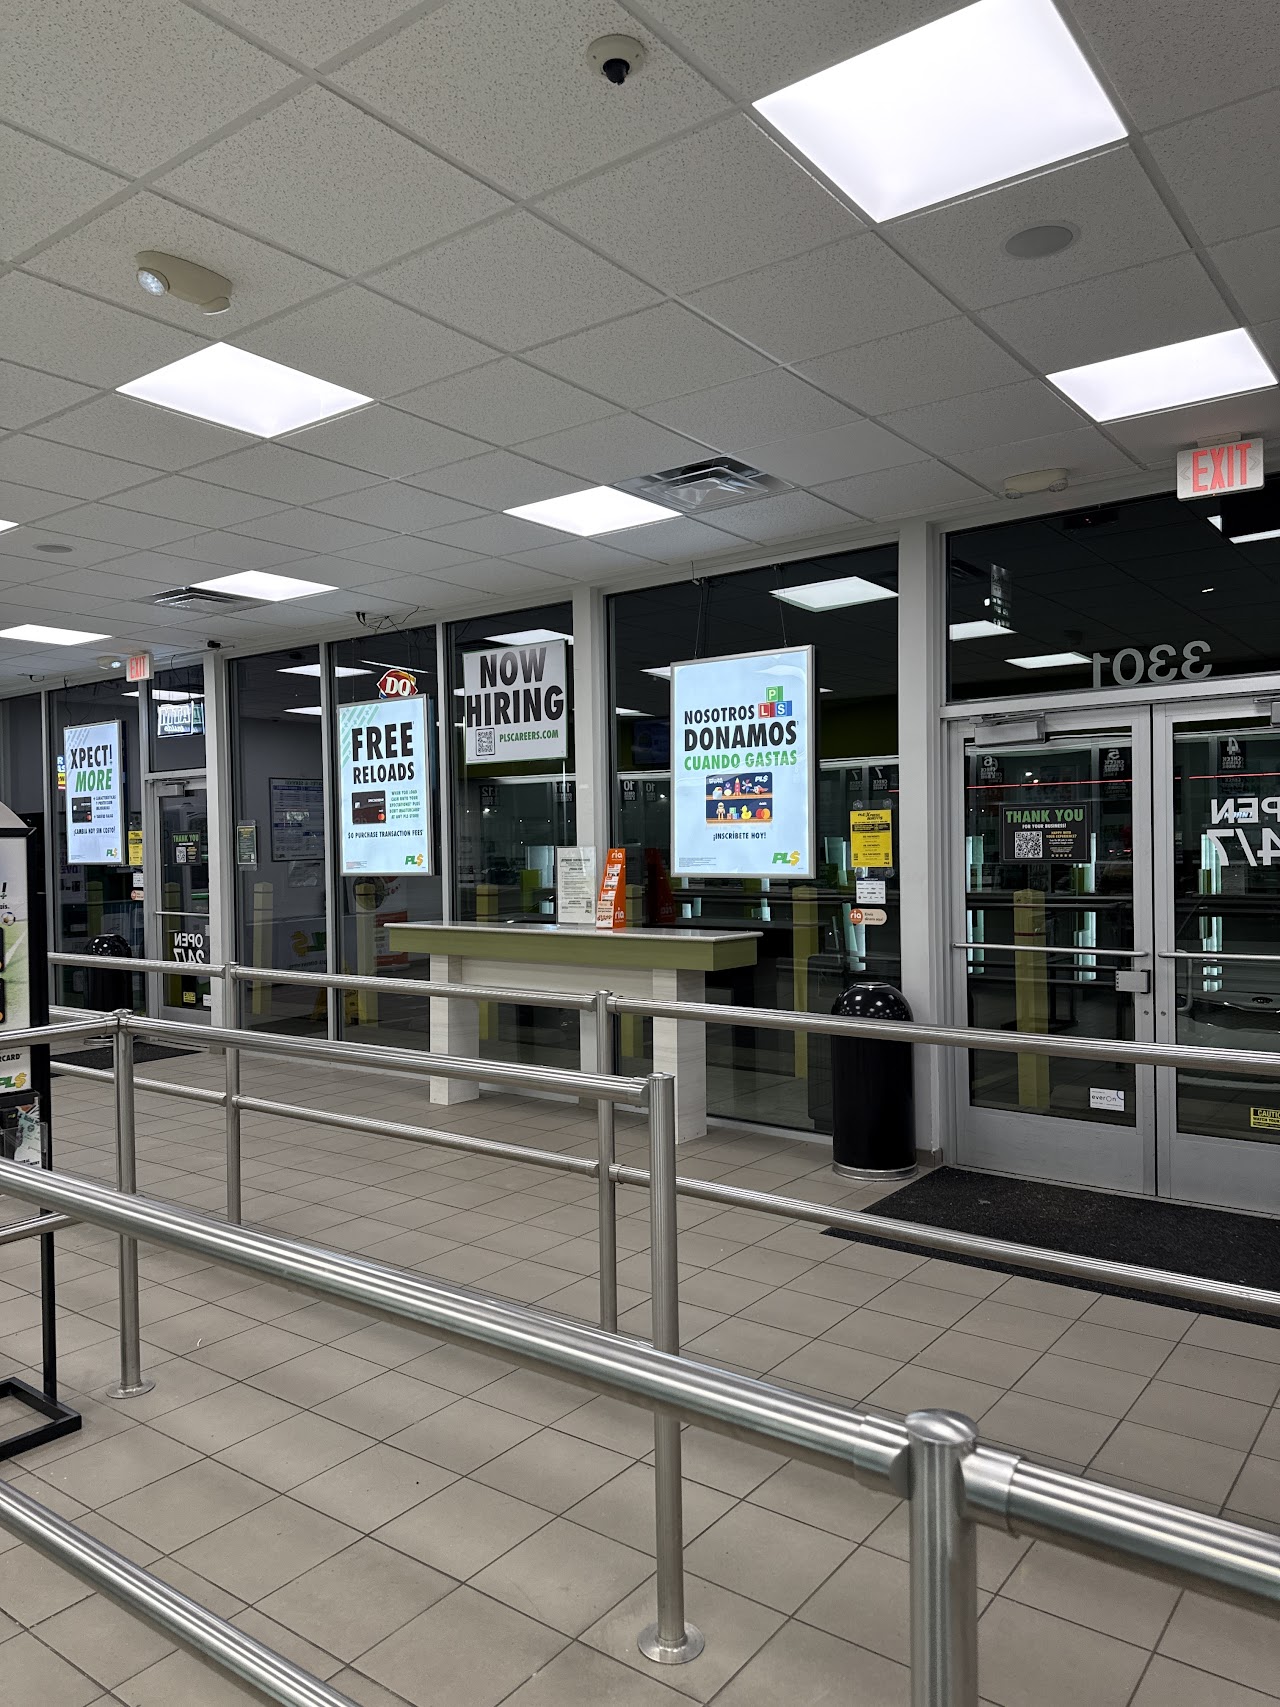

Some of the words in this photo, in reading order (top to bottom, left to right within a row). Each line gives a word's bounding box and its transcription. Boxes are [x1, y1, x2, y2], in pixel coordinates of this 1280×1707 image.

[1192, 443, 1252, 493] EXIT
[130, 656, 146, 679] EXIT
[480, 647, 547, 689] NOW
[385, 676, 411, 696] DQ
[768, 689, 776, 700] P
[466, 685, 564, 728] HIRING
[684, 705, 755, 725] NOSOTROS
[352, 721, 414, 762] FREE
[499, 729, 559, 743] PLSCAREERS.COM
[684, 720, 797, 752] DONAMOS
[70, 744, 113, 770] XPECT!
[684, 753, 740, 771] CUANDO
[745, 749, 798, 768] GASTAS
[75, 768, 112, 793] MORE
[353, 762, 415, 785] RELOADS
[1005, 809, 1051, 824] THANK
[1054, 808, 1084, 822] YOU
[173, 834, 188, 842] THANK
[189, 834, 199, 842] YOU
[355, 831, 378, 839] PURCHASE
[379, 830, 411, 838] TRANSACTION
[713, 831, 749, 841] ¡INSCRÍBETE
[751, 832, 767, 840] HOY!
[611, 849, 623, 859] ria
[615, 906, 625, 919] ria
[850, 910, 862, 919] ria
